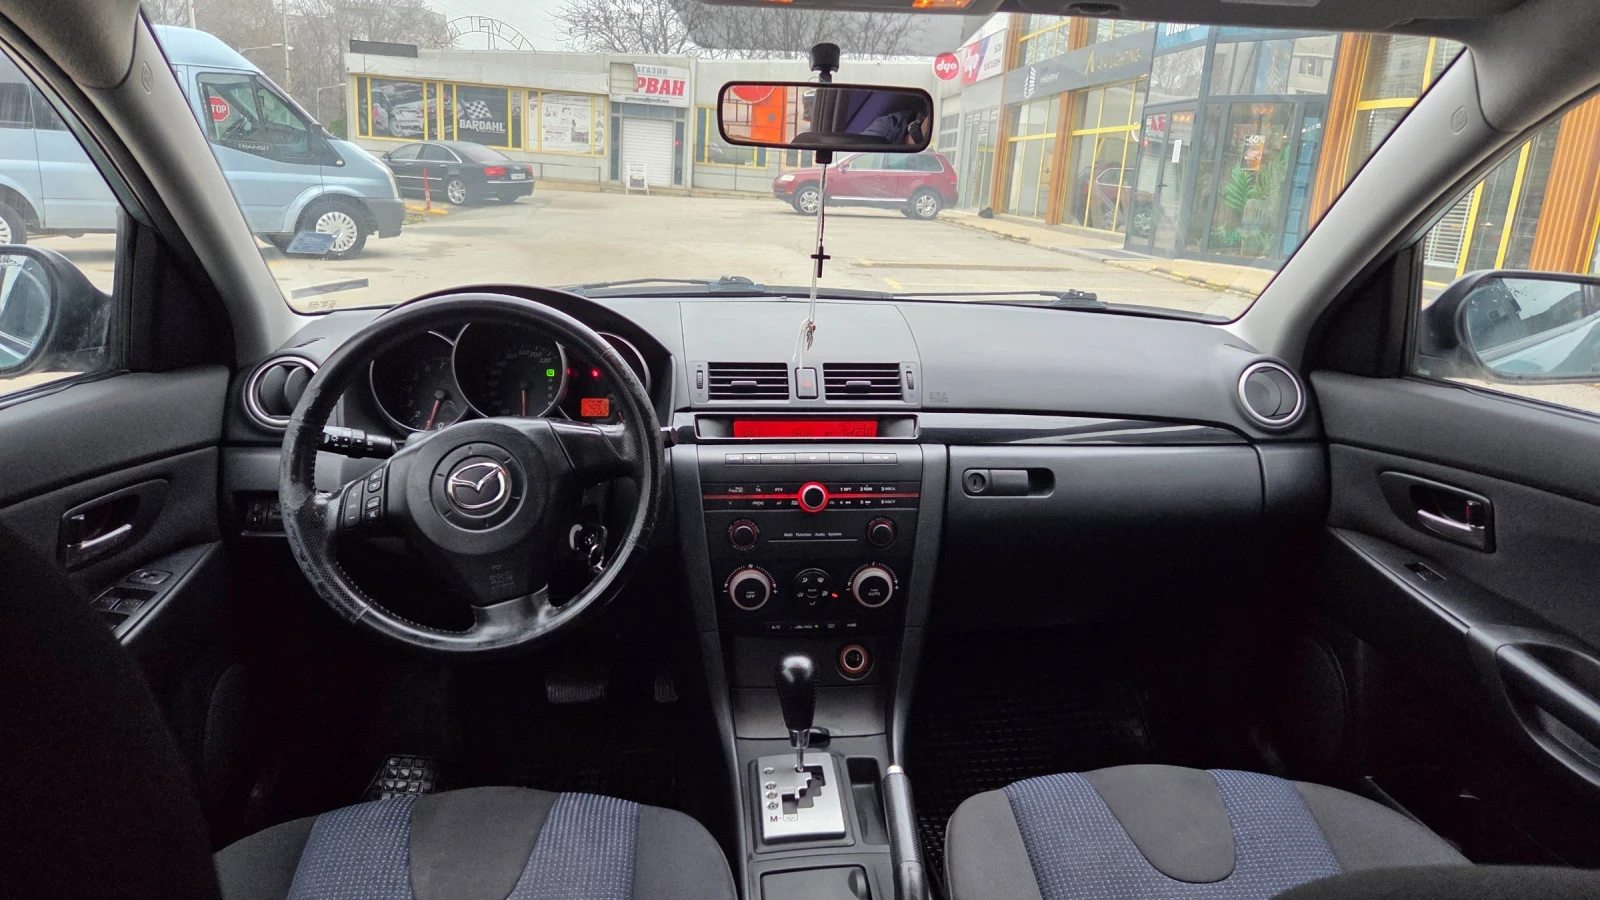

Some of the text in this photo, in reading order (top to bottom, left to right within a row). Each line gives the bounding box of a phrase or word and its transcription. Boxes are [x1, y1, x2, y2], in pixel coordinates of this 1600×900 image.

[636, 66, 668, 76] АГАЗИН
[936, 60, 958, 74] dyo
[211, 104, 227, 114] TOP
[459, 118, 506, 133] BARDAHL
[237, 143, 270, 151] TRANSIT
